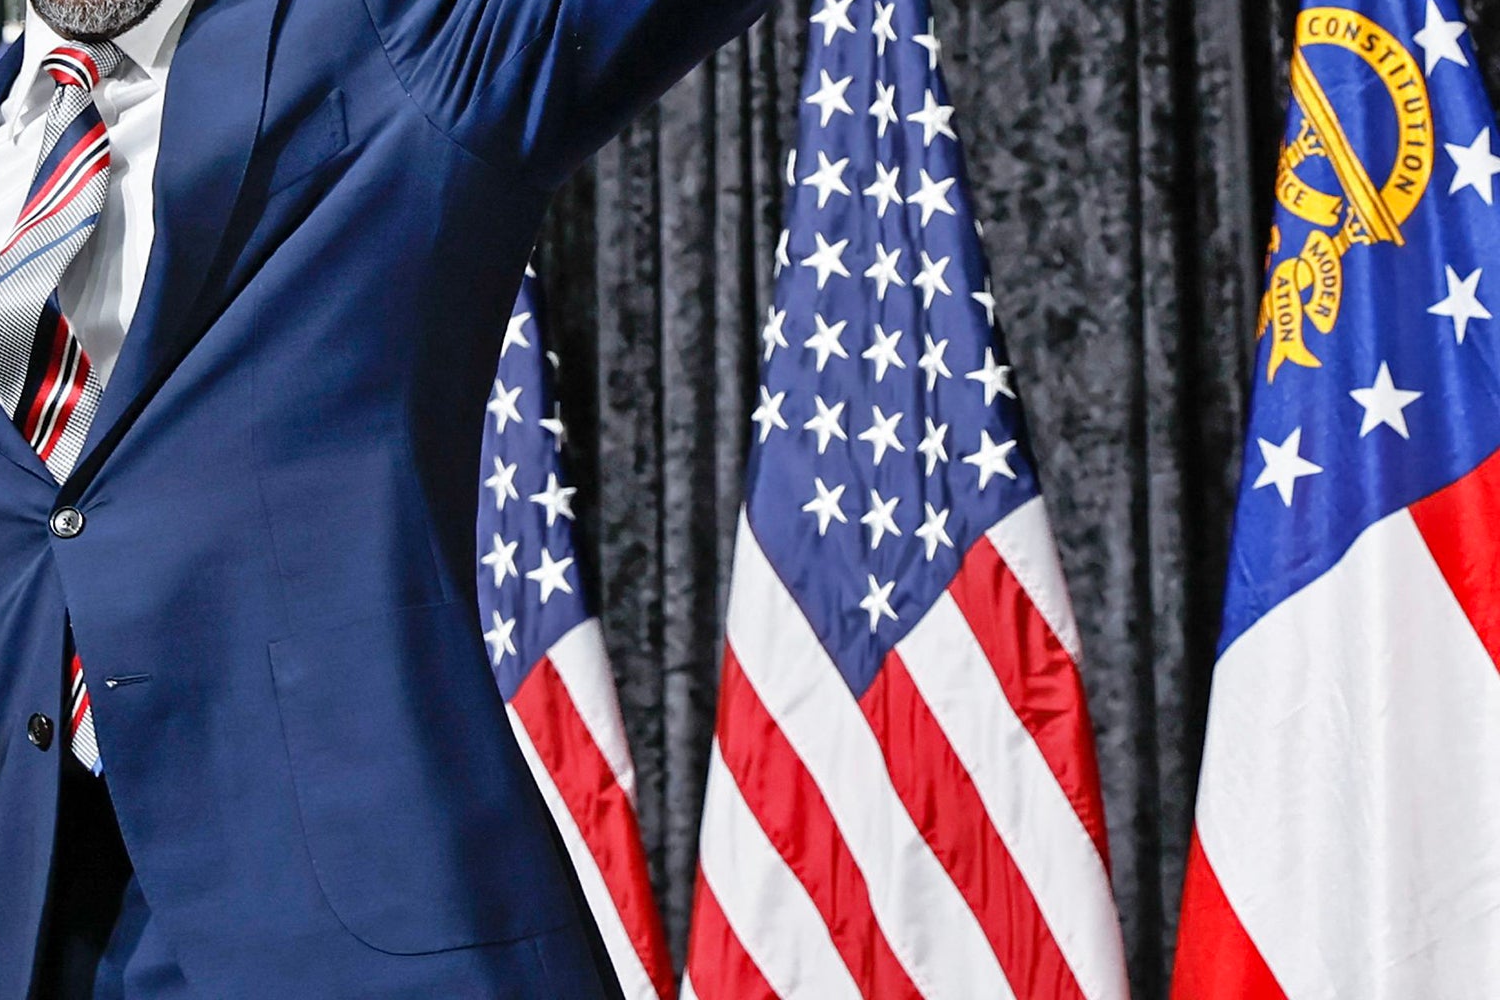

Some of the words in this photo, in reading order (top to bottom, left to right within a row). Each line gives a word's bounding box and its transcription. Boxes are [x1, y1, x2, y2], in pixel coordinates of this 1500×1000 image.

[1308, 16, 1427, 195] CONSTITUTION
[1277, 275, 1295, 342] ATION
[1309, 241, 1337, 318] MODER
